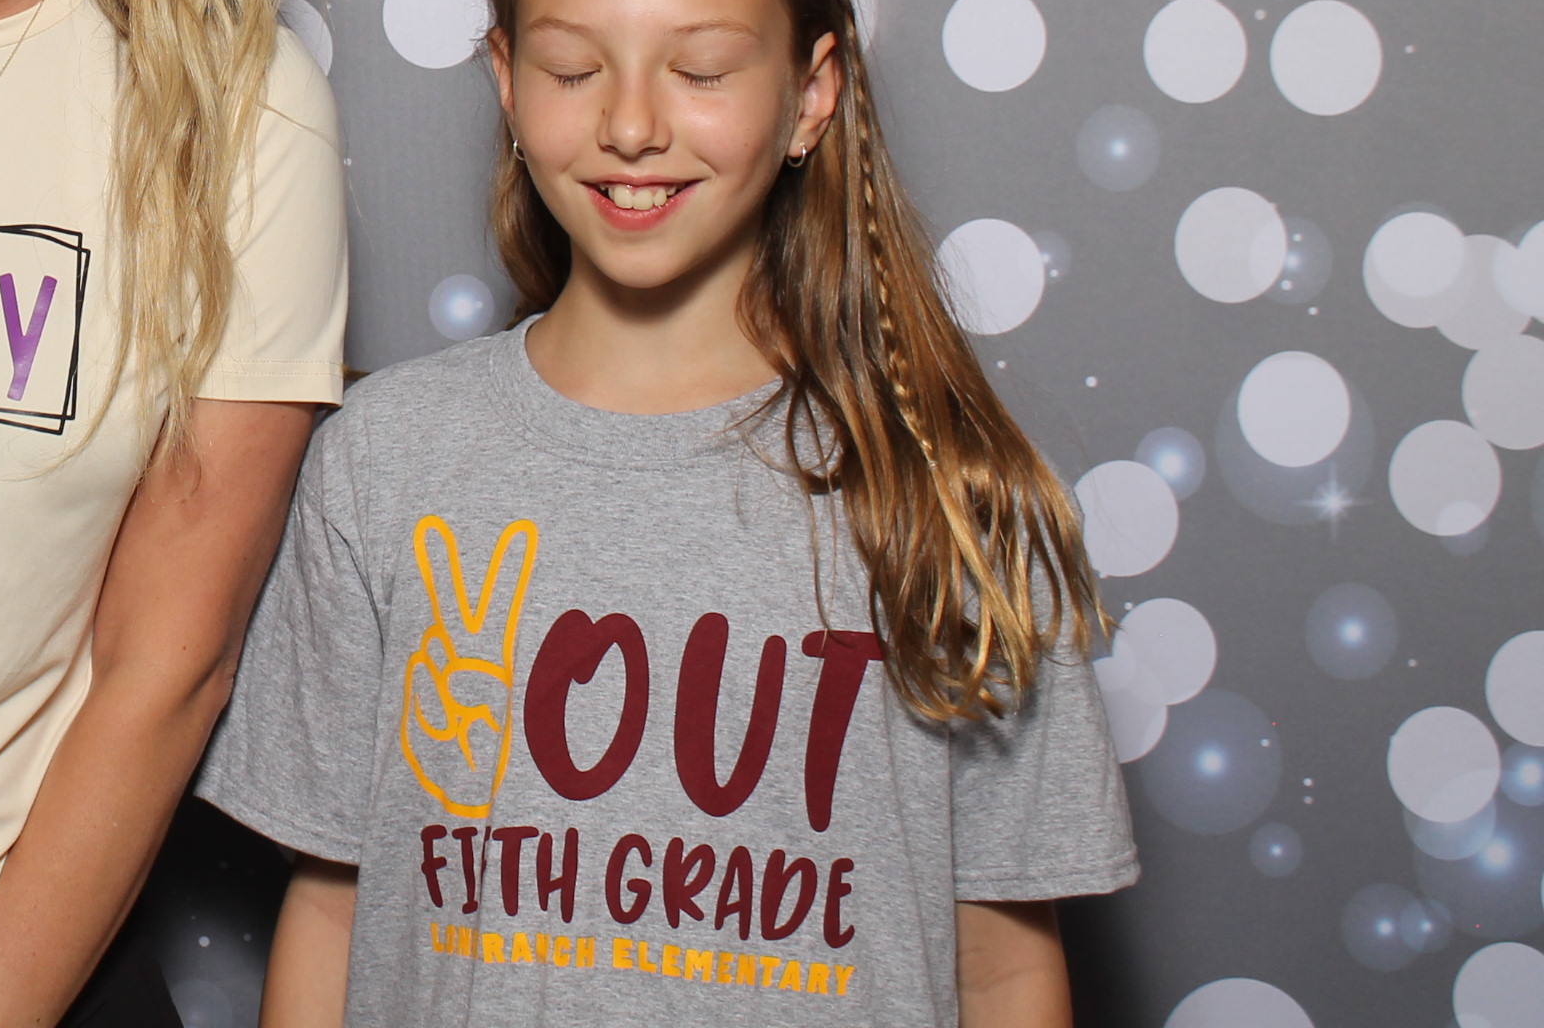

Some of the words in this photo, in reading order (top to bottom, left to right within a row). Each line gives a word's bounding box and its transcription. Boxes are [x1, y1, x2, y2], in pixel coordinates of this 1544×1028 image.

[524, 609, 888, 833] OUT
[605, 833, 855, 948] GRADE
[481, 932, 595, 968] RANCH
[612, 937, 855, 996] ELEMENTARY
